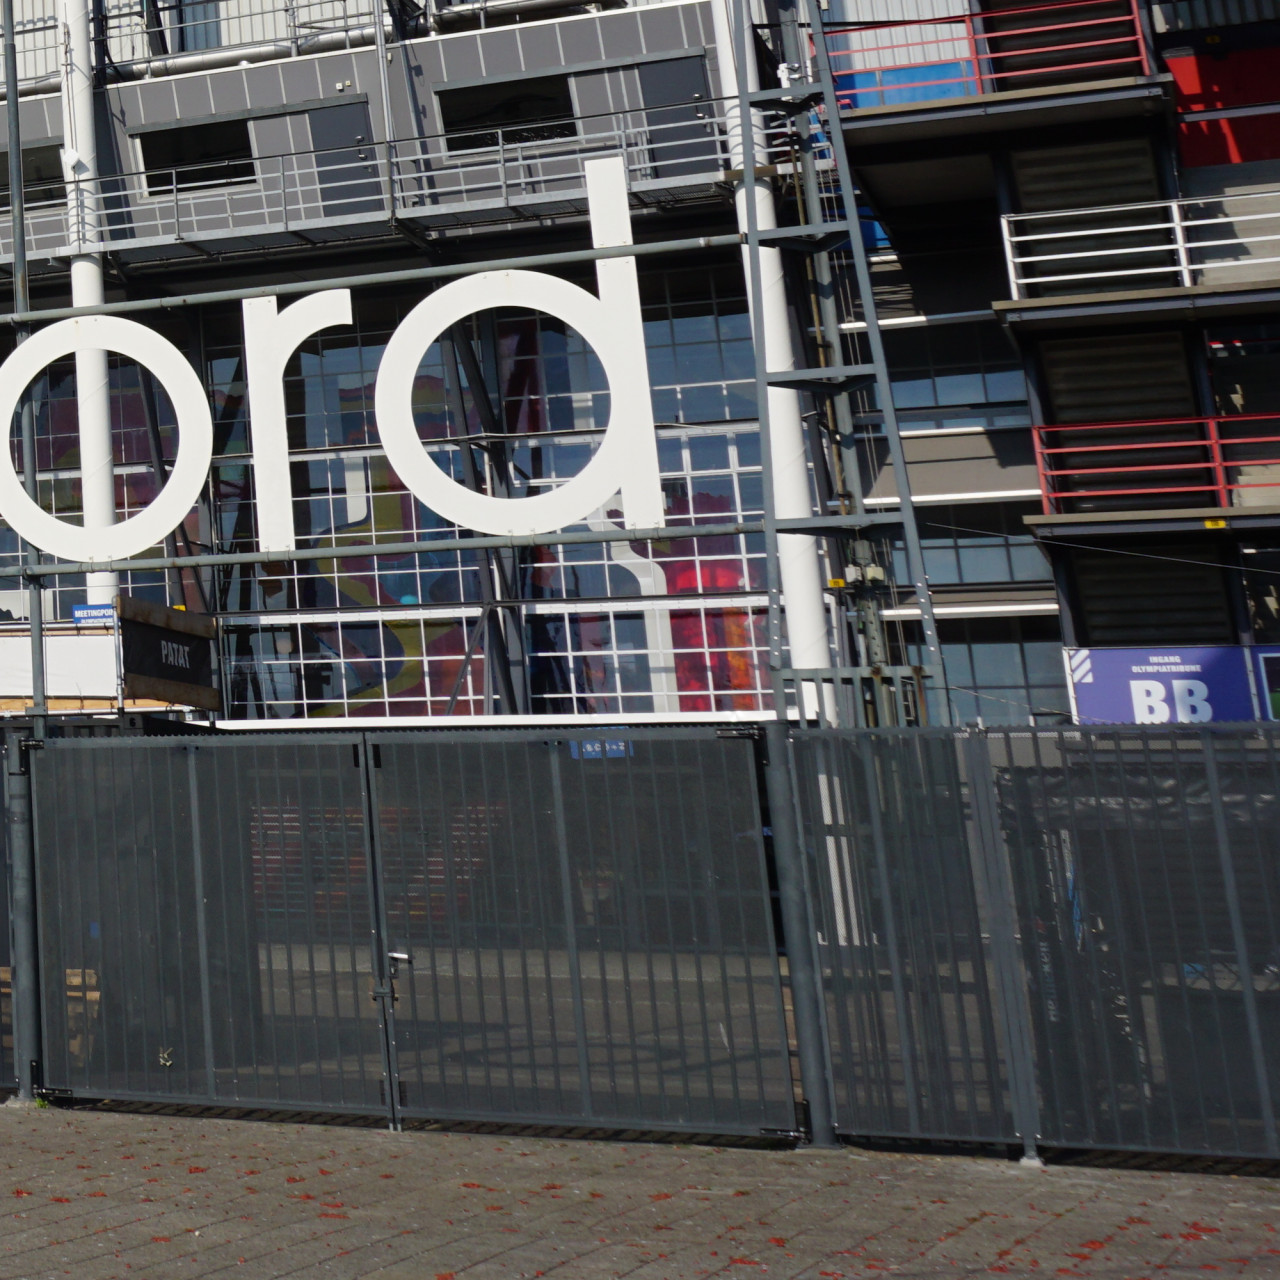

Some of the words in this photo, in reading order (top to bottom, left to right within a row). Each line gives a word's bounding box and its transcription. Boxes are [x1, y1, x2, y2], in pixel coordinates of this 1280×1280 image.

[161, 639, 190, 669] PATAT
[1149, 655, 1181, 663] INGANG
[1130, 680, 1213, 724] BB
